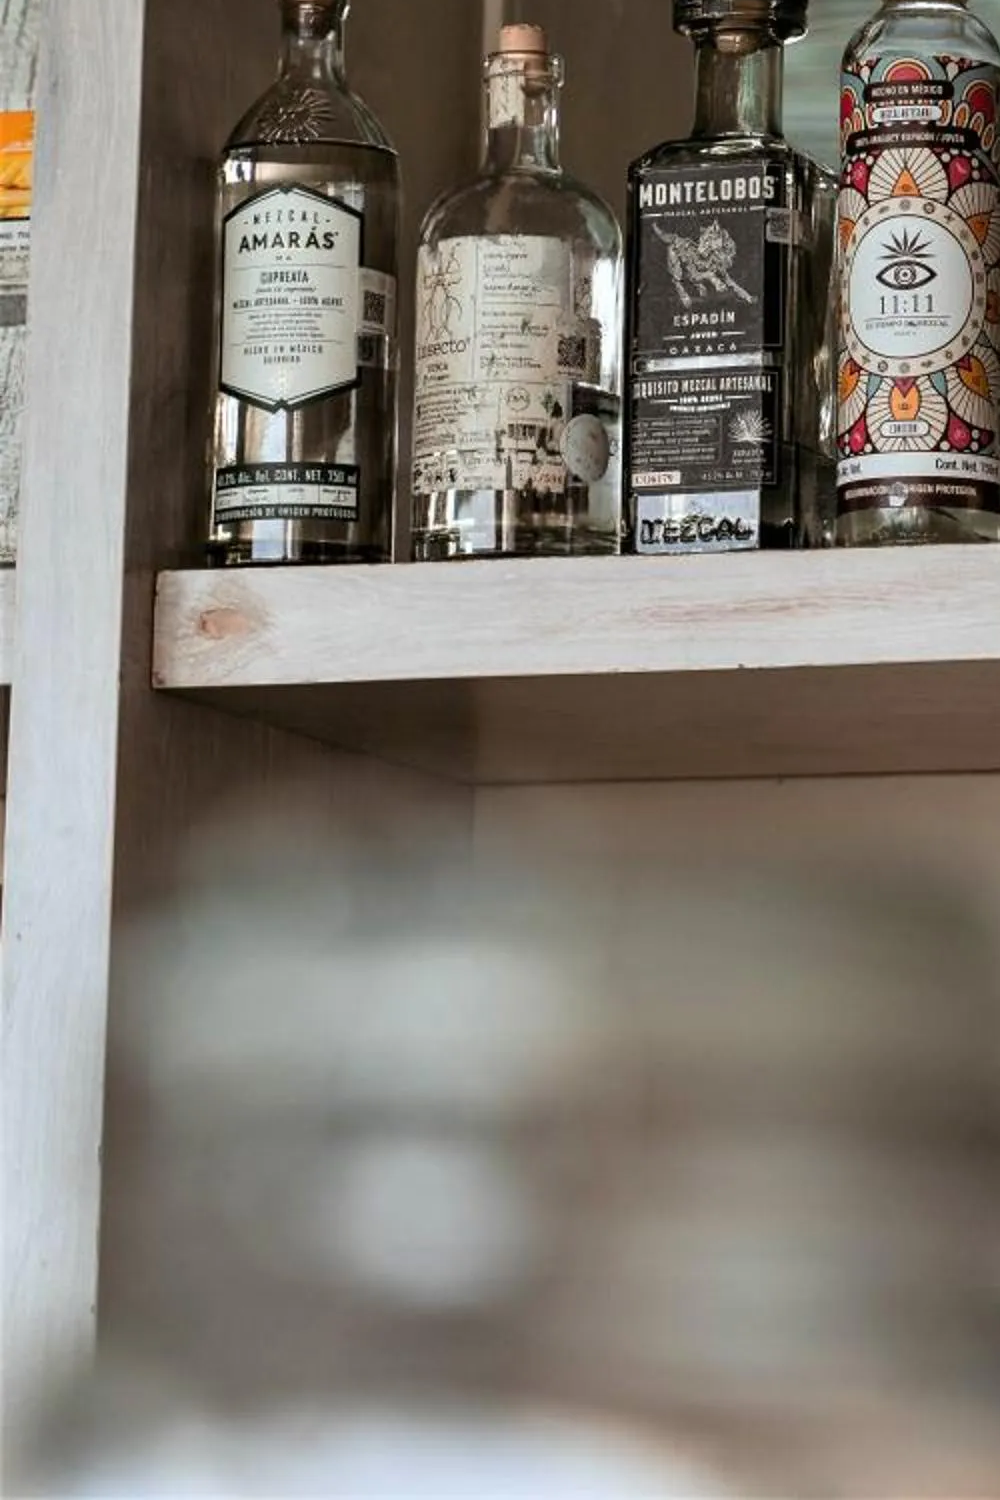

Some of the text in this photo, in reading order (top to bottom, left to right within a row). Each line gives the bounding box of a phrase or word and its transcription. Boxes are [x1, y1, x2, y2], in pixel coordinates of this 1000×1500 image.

[911, 84, 944, 95] MÉXICO
[639, 175, 776, 209] MONTELOBOS
[238, 225, 336, 255] AMARÁS
[879, 293, 934, 315] 11:11
[673, 309, 736, 327] ESPADÍN
[681, 378, 717, 394] MEZCAL
[719, 375, 773, 393] ARTESANAL
[935, 457, 959, 470] Cont.
[273, 469, 301, 482] CONT.
[305, 469, 325, 482] NET.
